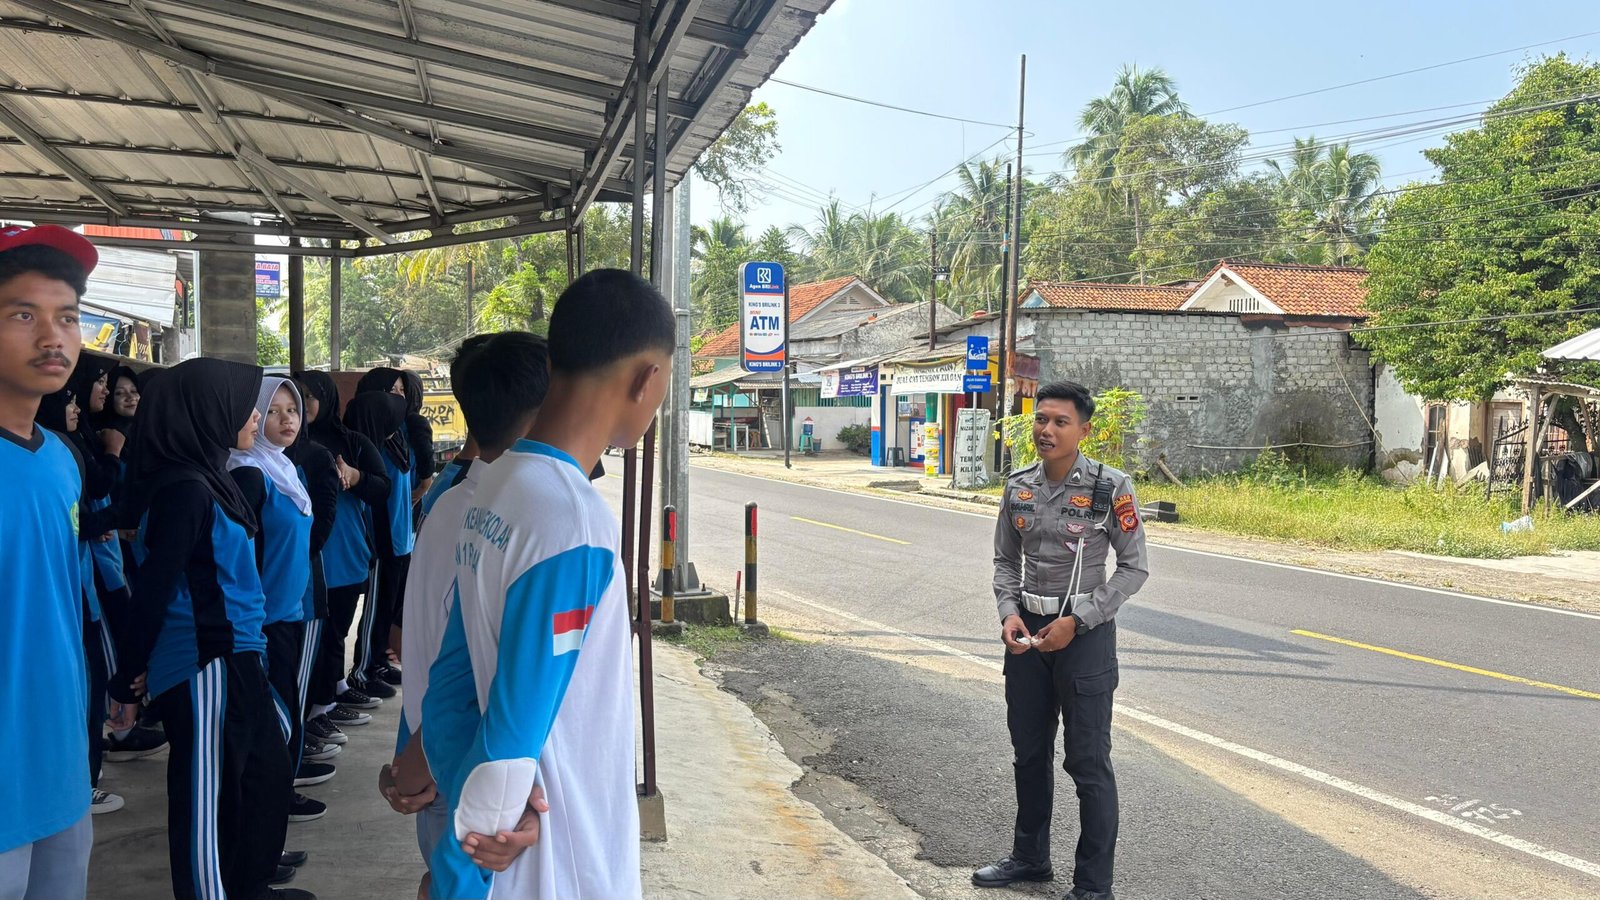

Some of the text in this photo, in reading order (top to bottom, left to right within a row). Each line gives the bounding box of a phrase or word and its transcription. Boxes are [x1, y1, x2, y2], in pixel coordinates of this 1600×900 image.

[750, 315, 779, 330] ATM
[960, 455, 983, 463] TEMOK
[1061, 507, 1096, 520] POLRI
